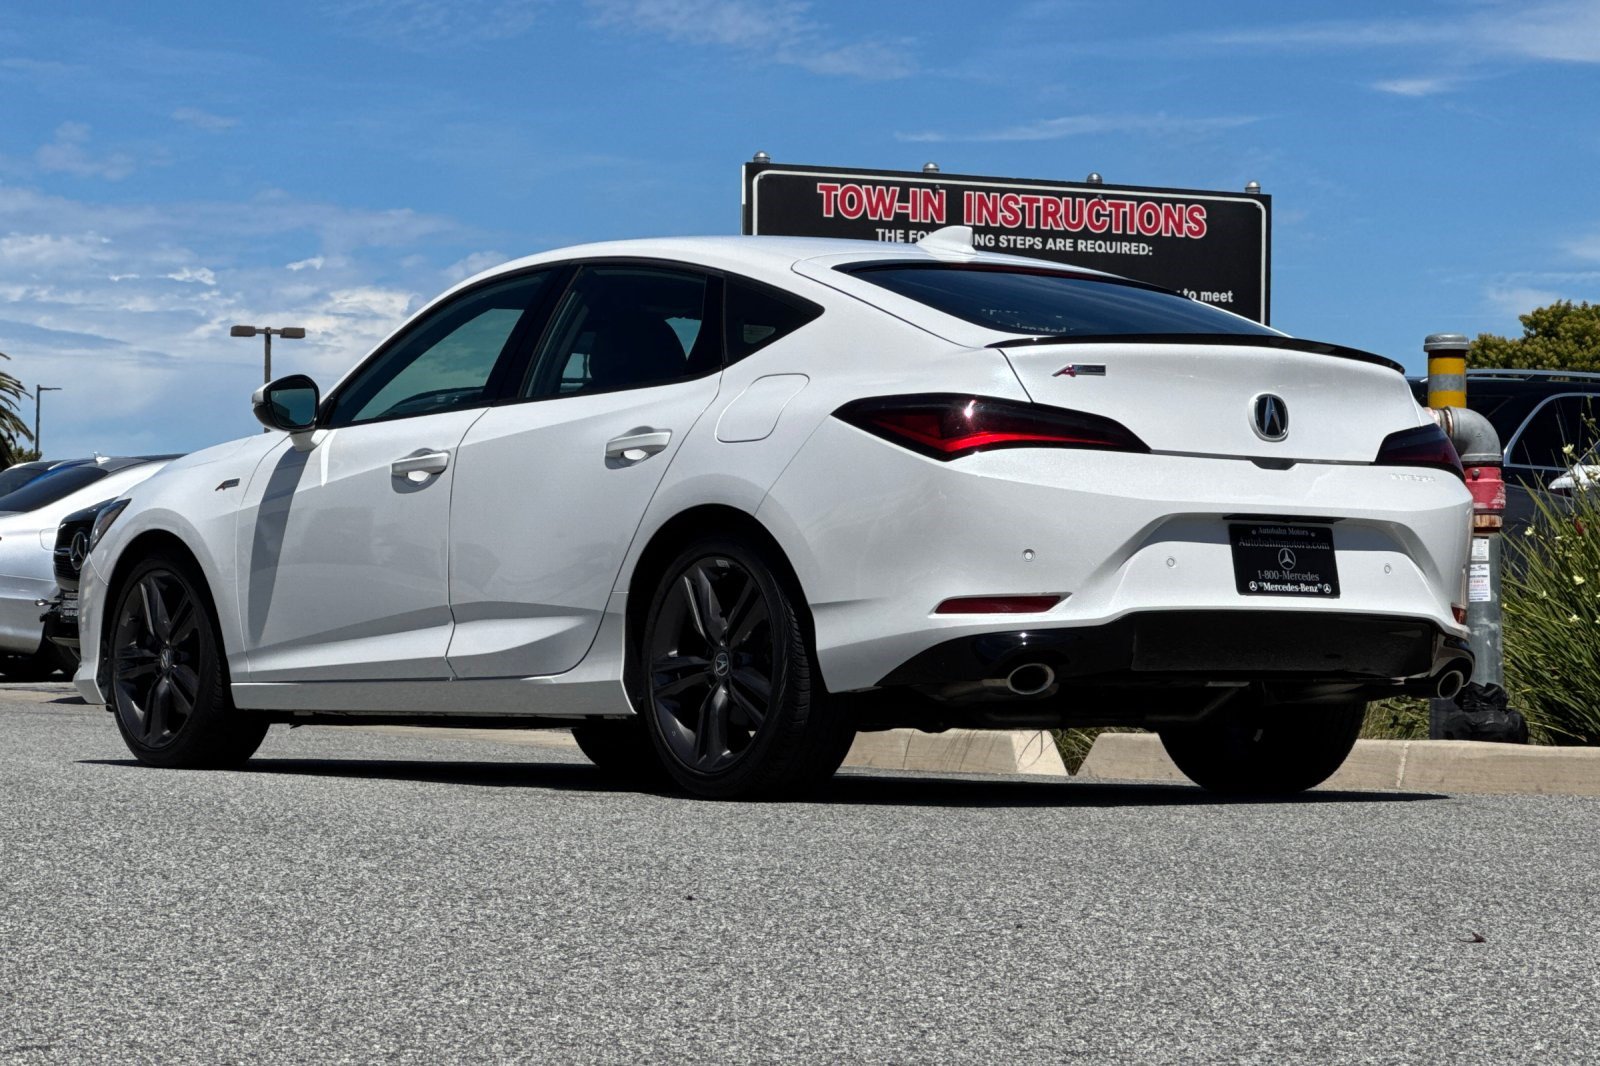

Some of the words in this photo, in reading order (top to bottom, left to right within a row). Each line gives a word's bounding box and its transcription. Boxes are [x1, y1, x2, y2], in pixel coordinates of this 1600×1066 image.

[817, 182, 946, 224] TOW-IN
[963, 190, 1207, 239] INSTRUCTIONS
[875, 228, 905, 243] THE
[998, 235, 1043, 250] STEPS
[1045, 238, 1074, 252] ARE
[1077, 239, 1153, 256] REQUIRED:
[1183, 288, 1197, 300] to
[1200, 290, 1234, 303] meet
[1258, 526, 1287, 536] Autobahn
[1287, 527, 1309, 537] Motors
[1257, 570, 1320, 581] 1-800-Mercedes
[1263, 582, 1319, 593] Mercedes-Benz
